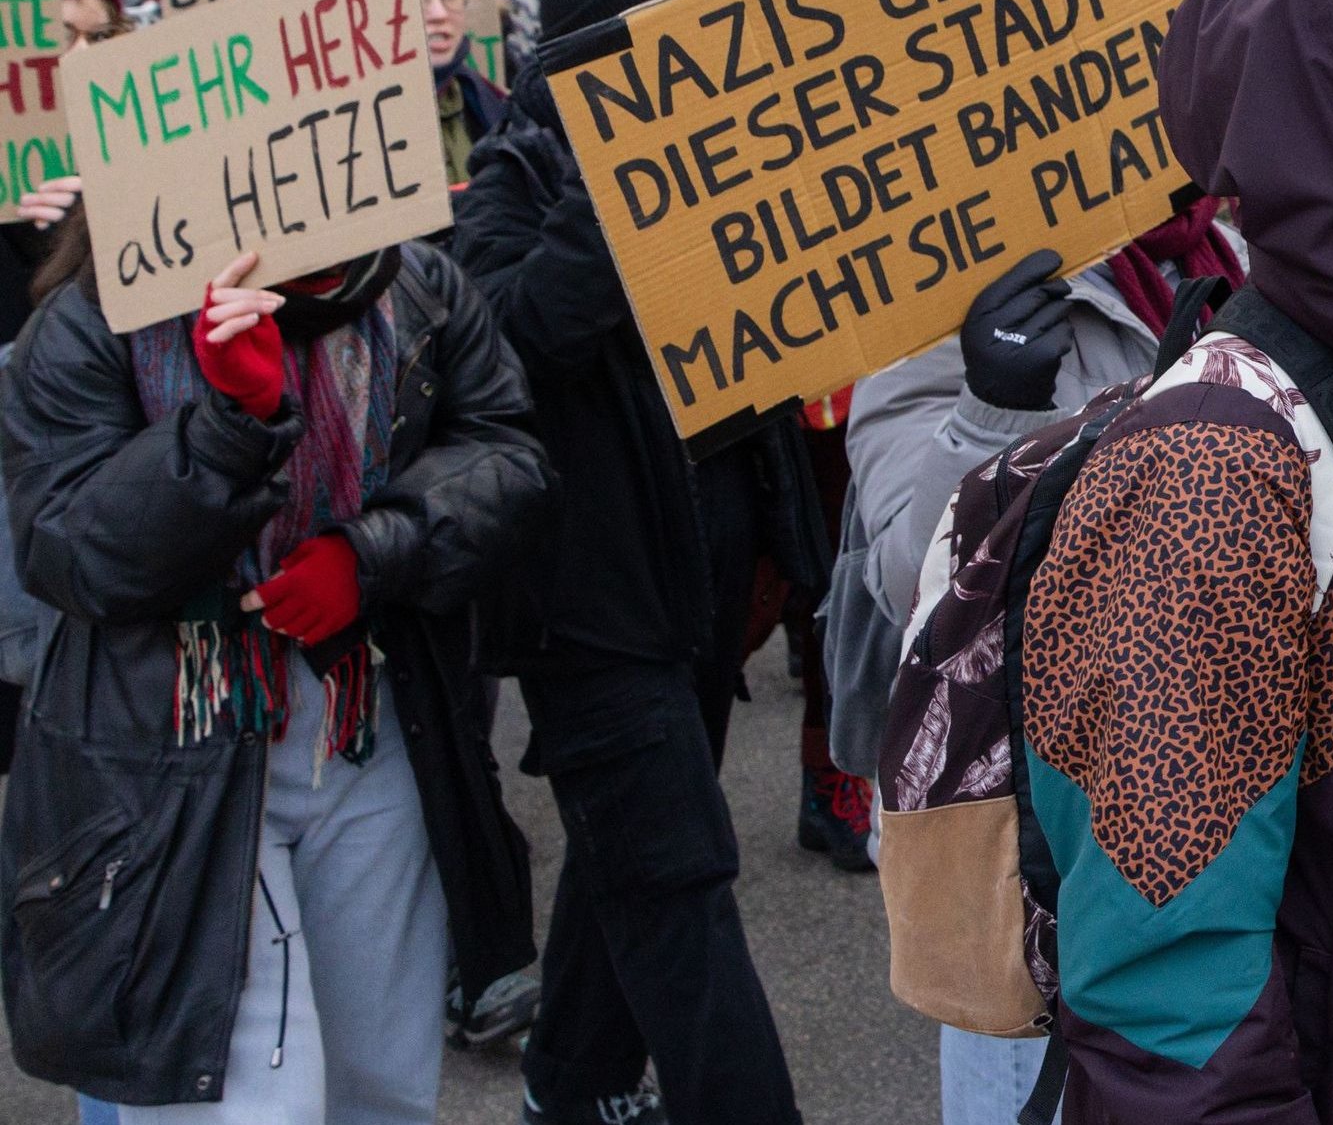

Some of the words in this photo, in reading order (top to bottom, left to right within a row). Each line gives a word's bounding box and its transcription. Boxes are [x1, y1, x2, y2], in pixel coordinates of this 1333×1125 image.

[88, 33, 270, 164] MEHR
[118, 195, 196, 286] als
[223, 84, 422, 252] HETZE
[614, 53, 899, 231] DIESER
[658, 235, 895, 408] MACHT
[908, 191, 1006, 293] SIE
[1030, 107, 1170, 227] PLAT
[711, 124, 942, 284] BILDET
